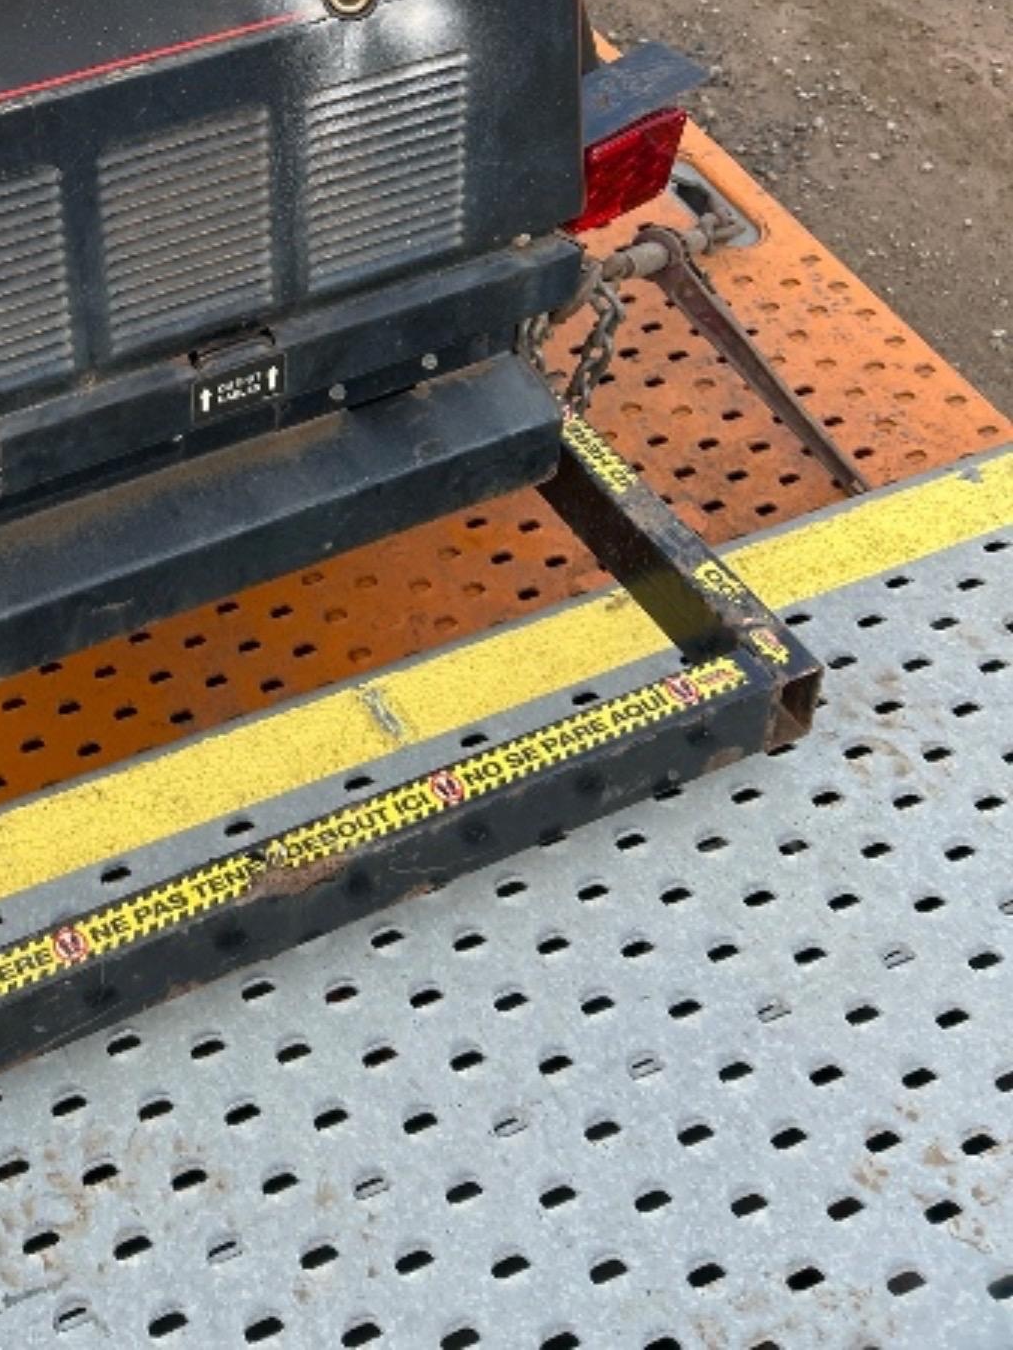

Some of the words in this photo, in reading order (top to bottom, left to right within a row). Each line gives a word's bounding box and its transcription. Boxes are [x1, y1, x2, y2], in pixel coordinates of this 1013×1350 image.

[463, 759, 503, 786] NO
[505, 748, 539, 770] SE
[543, 717, 607, 753] PARE
[89, 915, 130, 943] NE
[134, 895, 190, 923] PAS
[287, 807, 390, 859] DEBOUT
[394, 791, 431, 817] ICI
